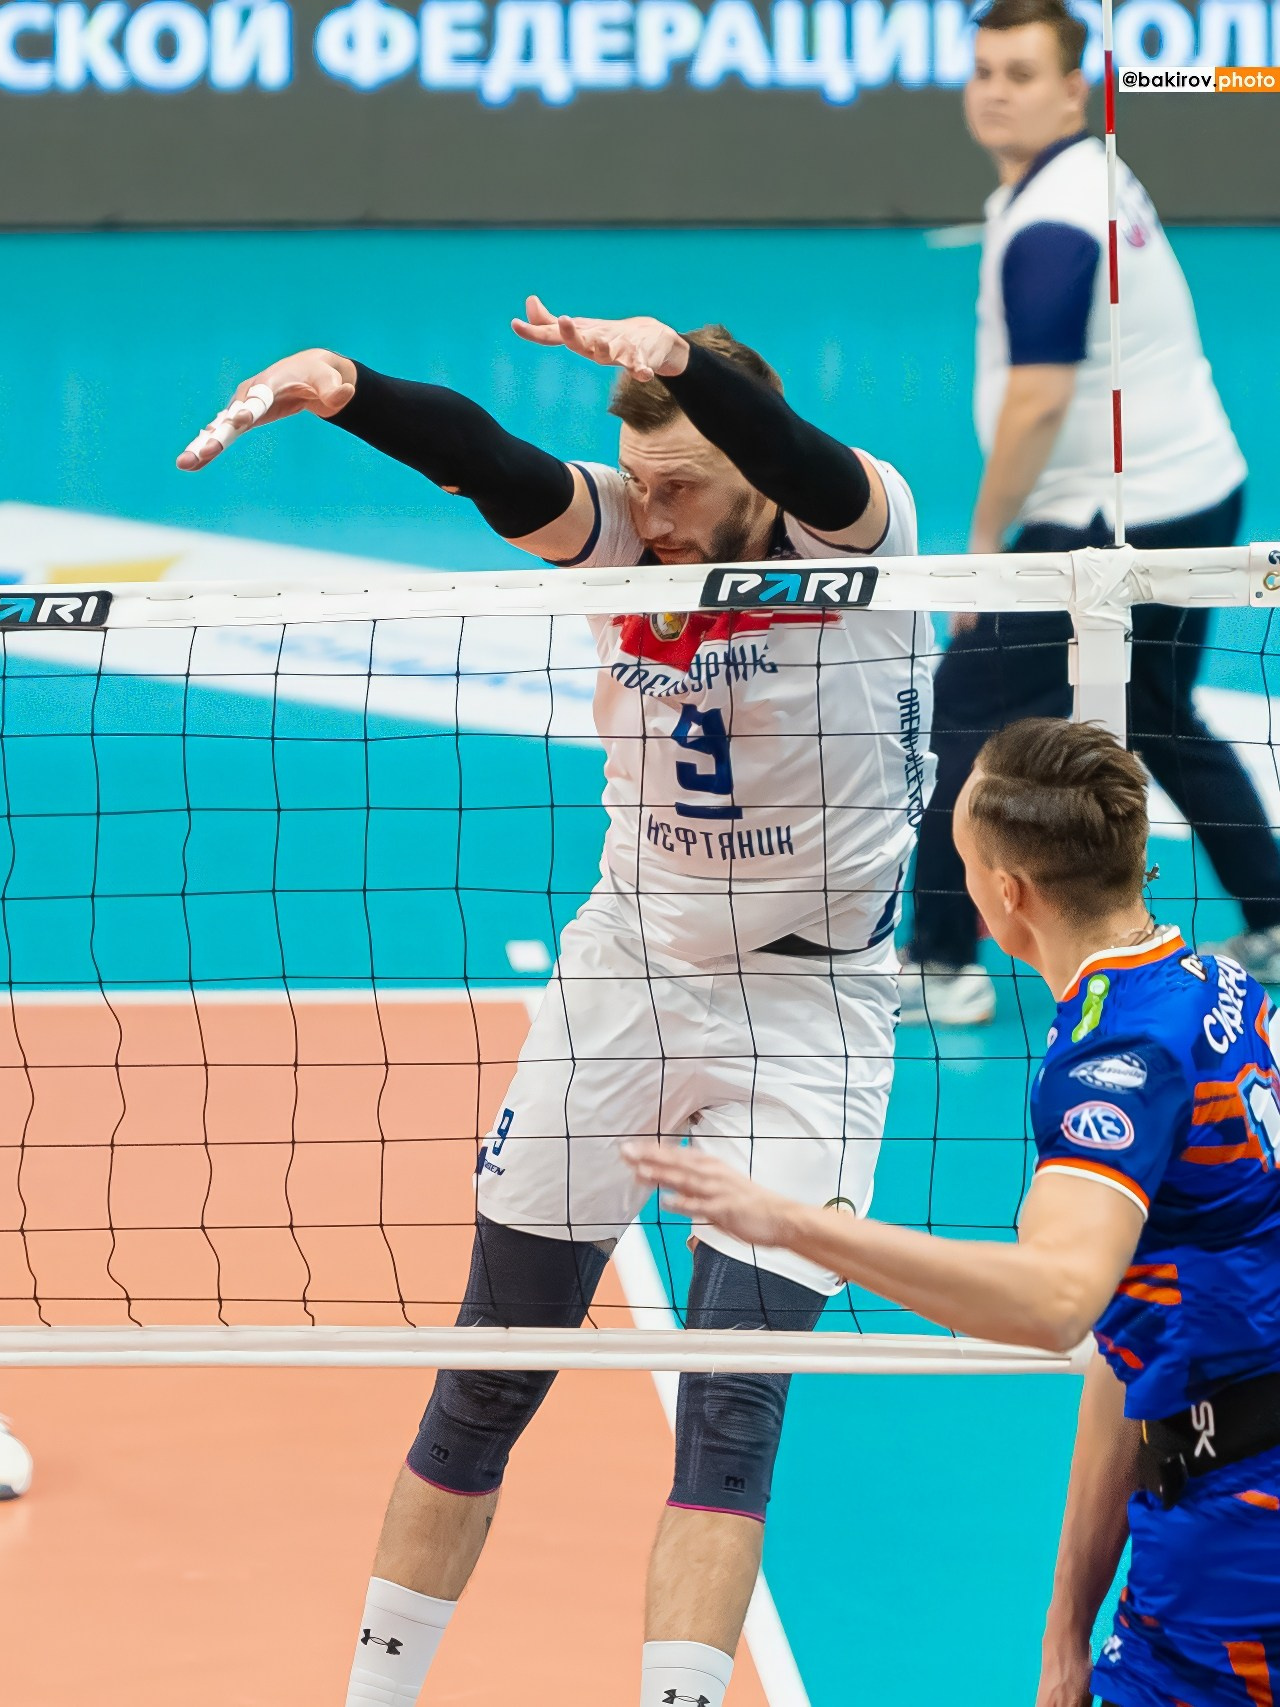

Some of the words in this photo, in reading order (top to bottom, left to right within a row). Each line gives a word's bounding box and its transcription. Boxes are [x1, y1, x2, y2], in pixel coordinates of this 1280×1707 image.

[717, 571, 864, 602] PARI
[671, 702, 734, 795] 9
[647, 813, 794, 861] НЕФТЯНИК
[492, 1107, 514, 1156] 9
